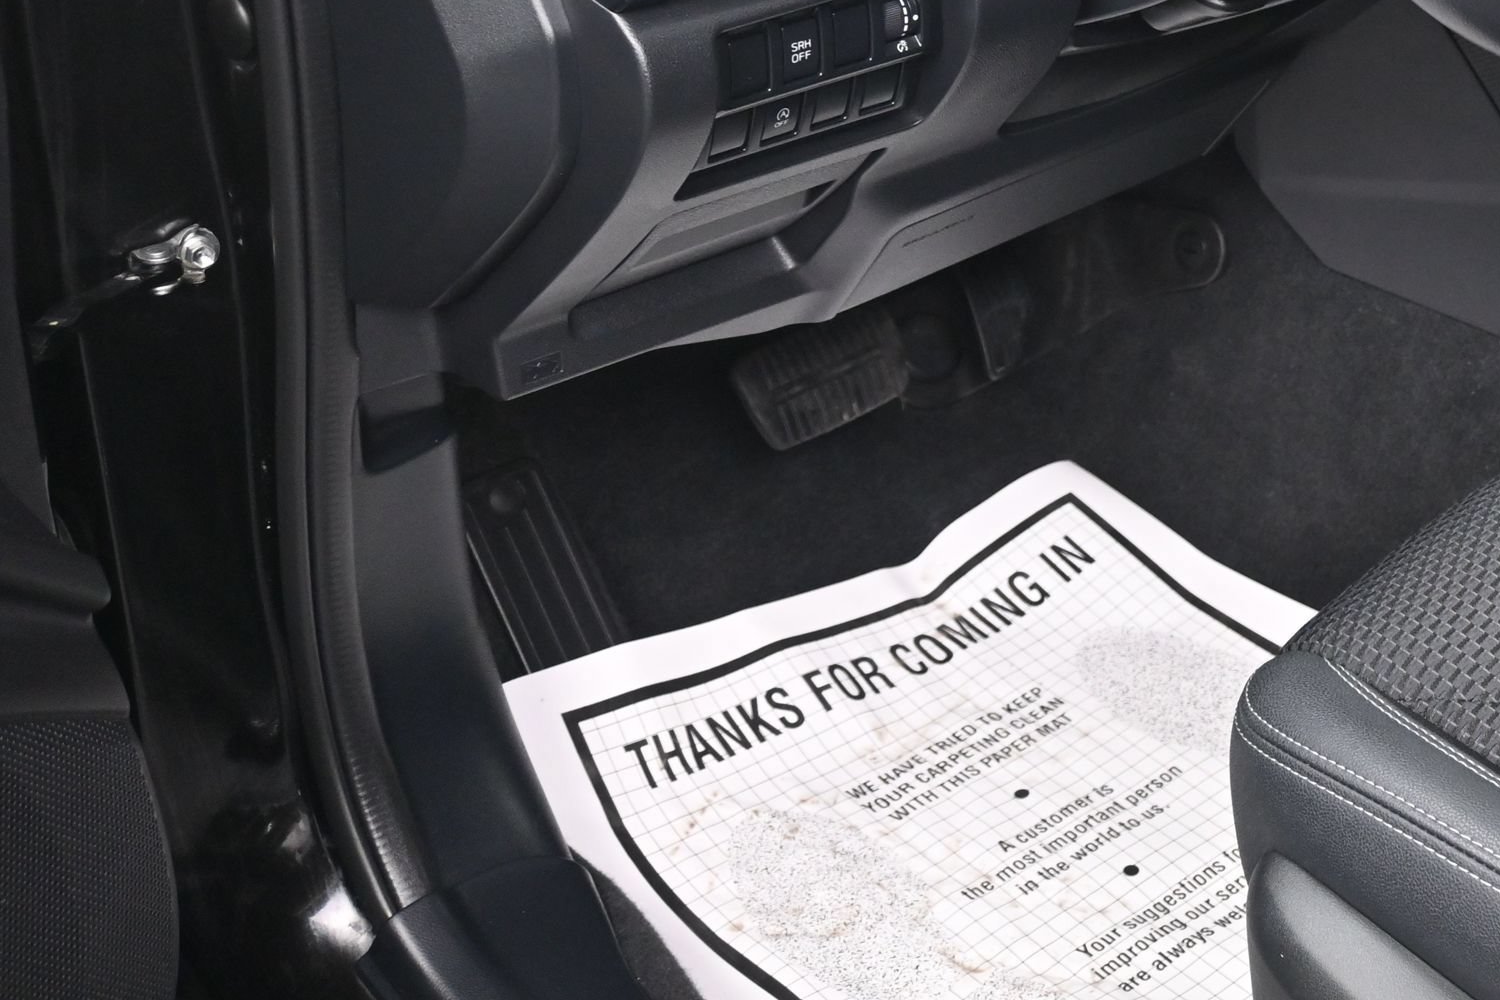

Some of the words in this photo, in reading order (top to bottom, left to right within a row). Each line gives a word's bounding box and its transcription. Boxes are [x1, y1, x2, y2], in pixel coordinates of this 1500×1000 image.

[790, 38, 812, 53] SRH
[791, 49, 812, 64] OFF
[624, 687, 805, 788] THANKS
[802, 656, 895, 712] FOR
[889, 570, 1050, 675] COMING
[1039, 535, 1095, 583] IN
[846, 780, 878, 800] WE
[878, 754, 927, 785] HAVE
[927, 724, 977, 755] TRIED
[977, 711, 1003, 726] TO
[1002, 687, 1043, 715] KEEP
[861, 784, 915, 814] YOUR
[915, 727, 1011, 784] CARPETING
[1010, 697, 1065, 730] CLEAN
[888, 790, 939, 821] WITH
[938, 765, 981, 793] THIS
[980, 734, 1038, 768] PAPER
[1036, 712, 1072, 738] MAT
[961, 879, 995, 901] the
[996, 849, 1043, 882] most
[1042, 800, 1126, 854] important
[1125, 765, 1183, 806] person
[998, 838, 1016, 853] A
[1016, 795, 1094, 844] customer
[1093, 784, 1114, 798] is
[1016, 879, 1039, 896] in
[1038, 860, 1070, 881] the
[1070, 827, 1121, 862] world
[1118, 816, 1141, 831] to
[1075, 927, 1123, 958] Your
[1123, 860, 1226, 930] suggestions
[1091, 917, 1188, 981] improving
[1185, 898, 1216, 920] our
[1118, 968, 1151, 993] are
[1151, 926, 1215, 972] always
[1214, 902, 1248, 929] wel
